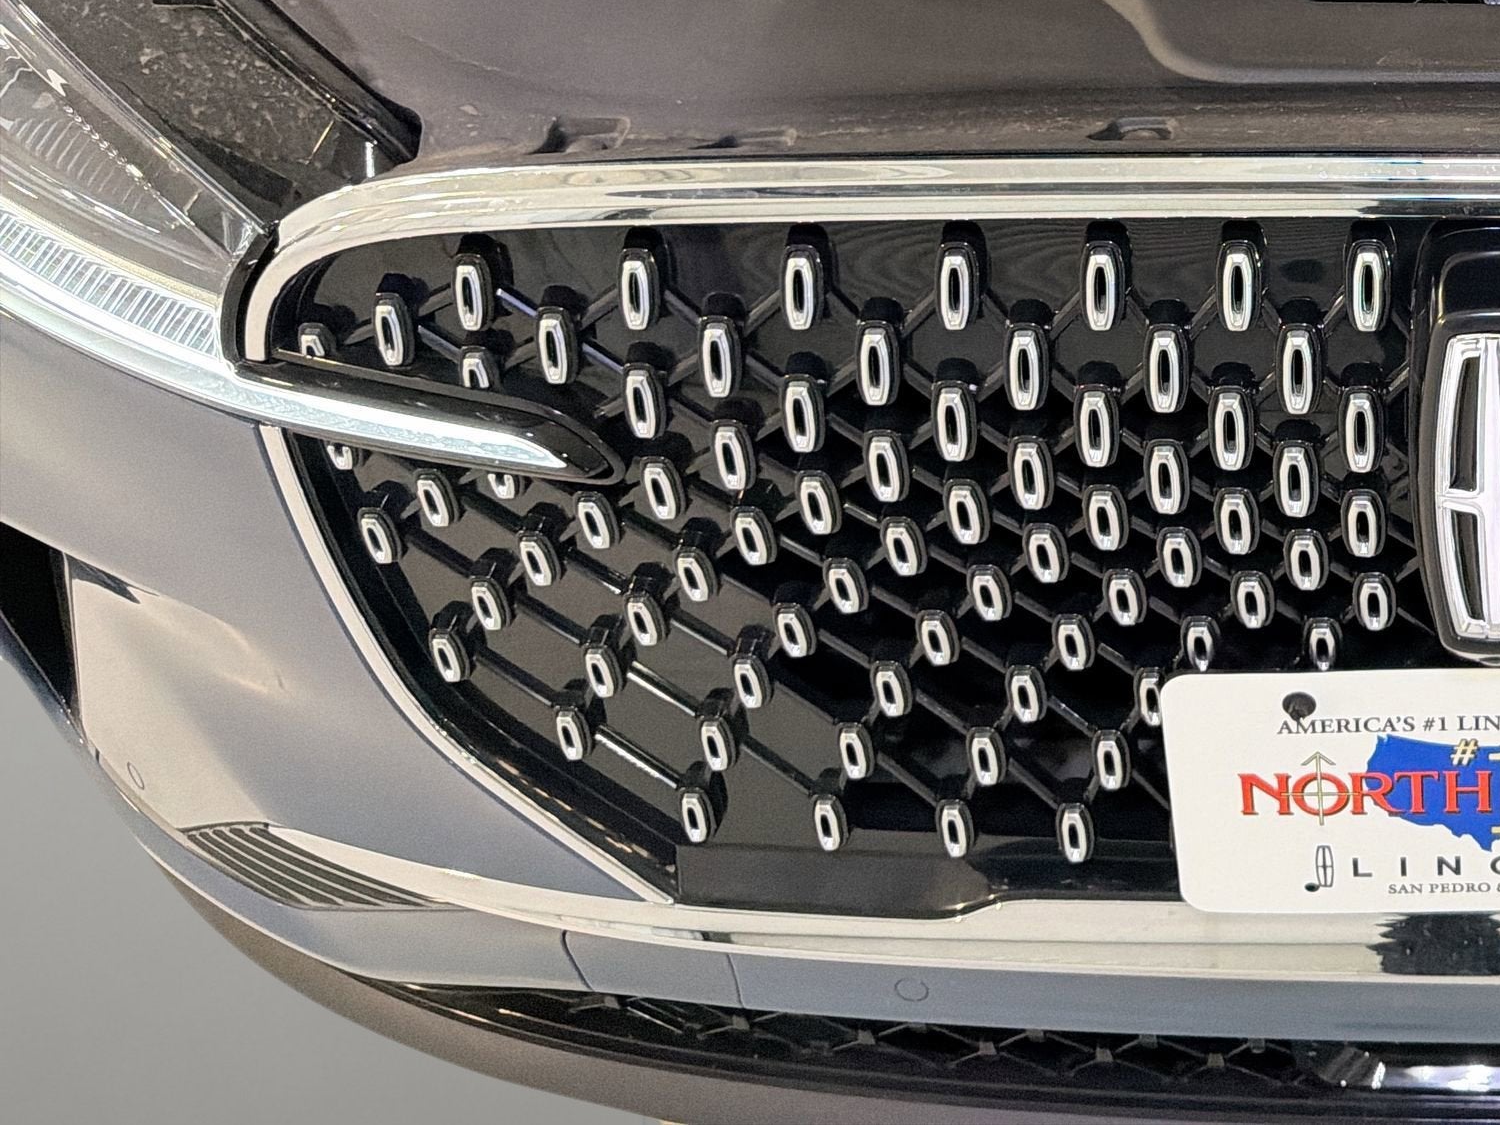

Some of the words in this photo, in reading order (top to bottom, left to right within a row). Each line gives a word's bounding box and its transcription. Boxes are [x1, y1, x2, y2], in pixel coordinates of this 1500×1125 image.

[1277, 716, 1415, 734] AMERICA'S
[1423, 717, 1448, 731] #1
[1237, 770, 1493, 816] NORTH
[1388, 883, 1423, 894] SAN
[1429, 882, 1491, 893] PEDRO
